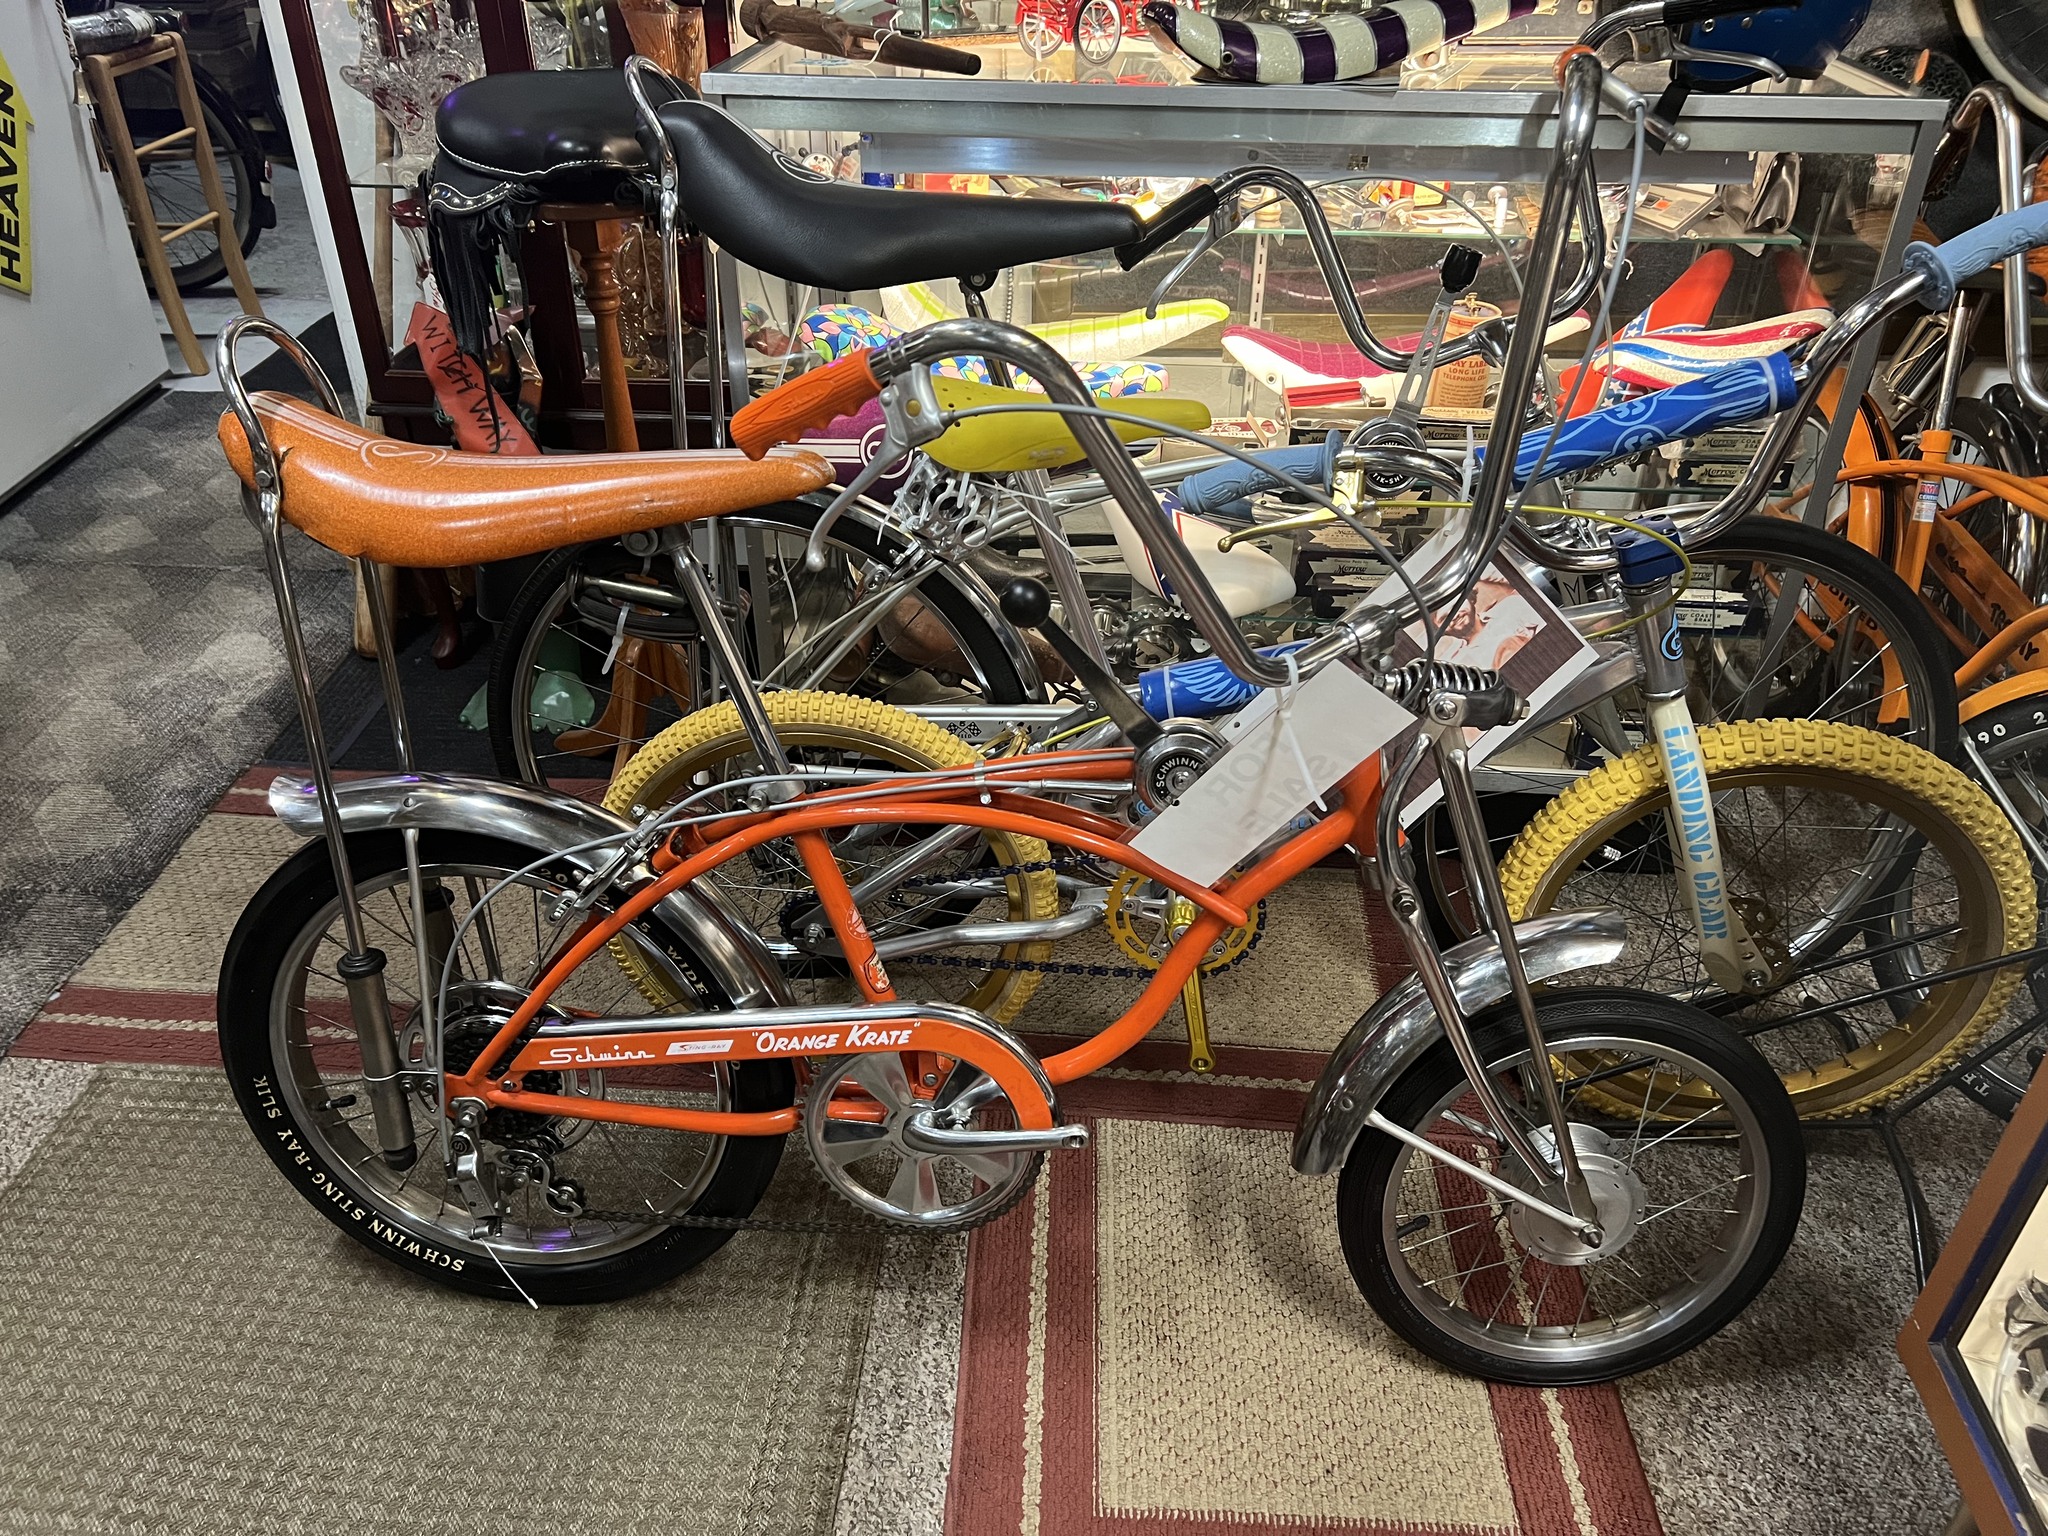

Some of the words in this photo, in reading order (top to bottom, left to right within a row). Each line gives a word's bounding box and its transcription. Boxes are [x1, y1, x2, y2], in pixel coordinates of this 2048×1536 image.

[0, 79, 21, 283] HEAVEN
[1443, 373, 1476, 381] TELEPHONE
[1449, 367, 1470, 375] LONG
[1334, 565, 1368, 574] Morrow
[1156, 757, 1200, 789] SCHWINN
[1663, 726, 1715, 863] LANDING
[1693, 871, 1729, 940] GEAR
[667, 945, 709, 995] WIDE
[539, 1044, 656, 1065] Schwinn
[253, 1075, 283, 1119] SLIK
[277, 1128, 366, 1222] STING-RAY
